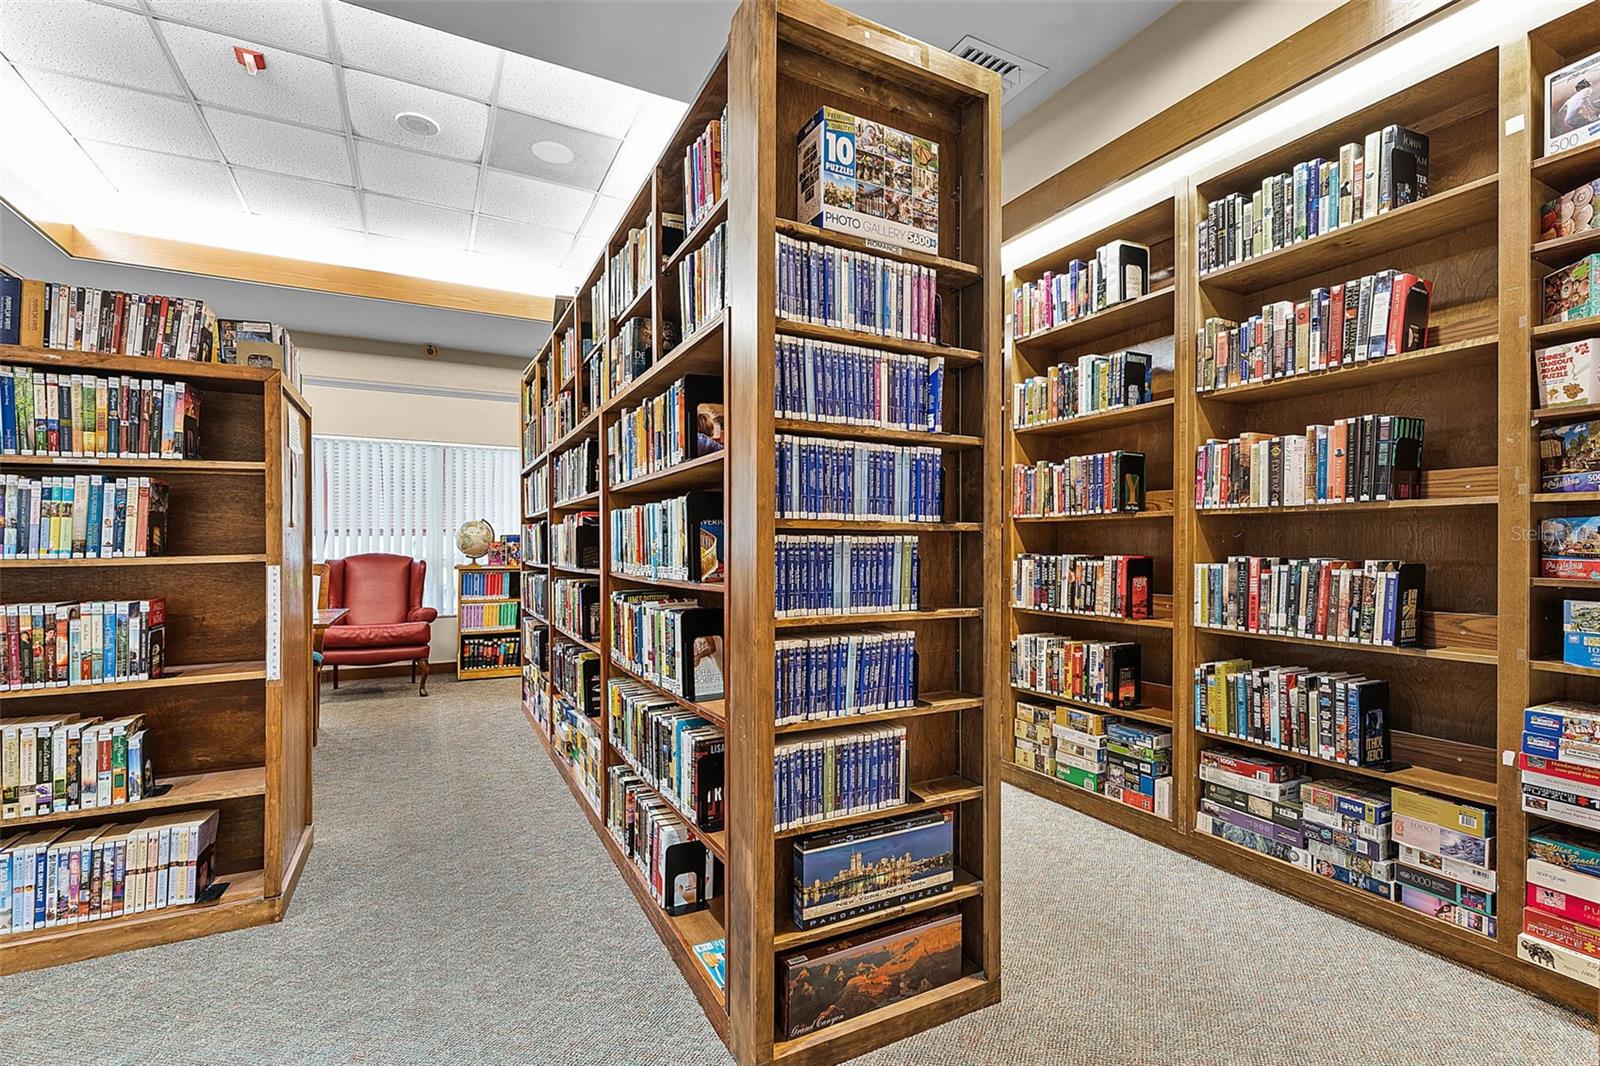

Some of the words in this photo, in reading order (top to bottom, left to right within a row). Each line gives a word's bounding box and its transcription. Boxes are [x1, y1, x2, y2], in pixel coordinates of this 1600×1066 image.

[827, 111, 854, 122] PREMIUM
[831, 121, 850, 132] QUALITY
[825, 131, 854, 165] 10
[1550, 133, 1580, 154] 500
[825, 163, 854, 176] PUZZLES
[825, 212, 861, 229] PHOTO
[863, 220, 906, 240] GALLERY
[907, 232, 931, 247] 5600
[866, 240, 901, 254] ROMANCE
[1538, 352, 1567, 363] CHINESE
[1540, 357, 1574, 368] TAKEOUT
[1540, 365, 1567, 375] JIGSAW
[1541, 371, 1568, 380] PUZZLE
[1238, 570, 1246, 593] HUSH
[1262, 687, 1270, 732] CONFESSIONAL
[1340, 801, 1363, 814] SPAM
[845, 834, 854, 844] 3
[1568, 854, 1600, 868] Beach!
[836, 898, 855, 908] NEW
[886, 886, 904, 898] NEW
[906, 879, 928, 892] YORK
[809, 900, 891, 927] PANORAMIC
[900, 884, 949, 902] PUZZLE
[789, 1017, 815, 1038] Grand
[815, 1011, 845, 1029] Canyon
